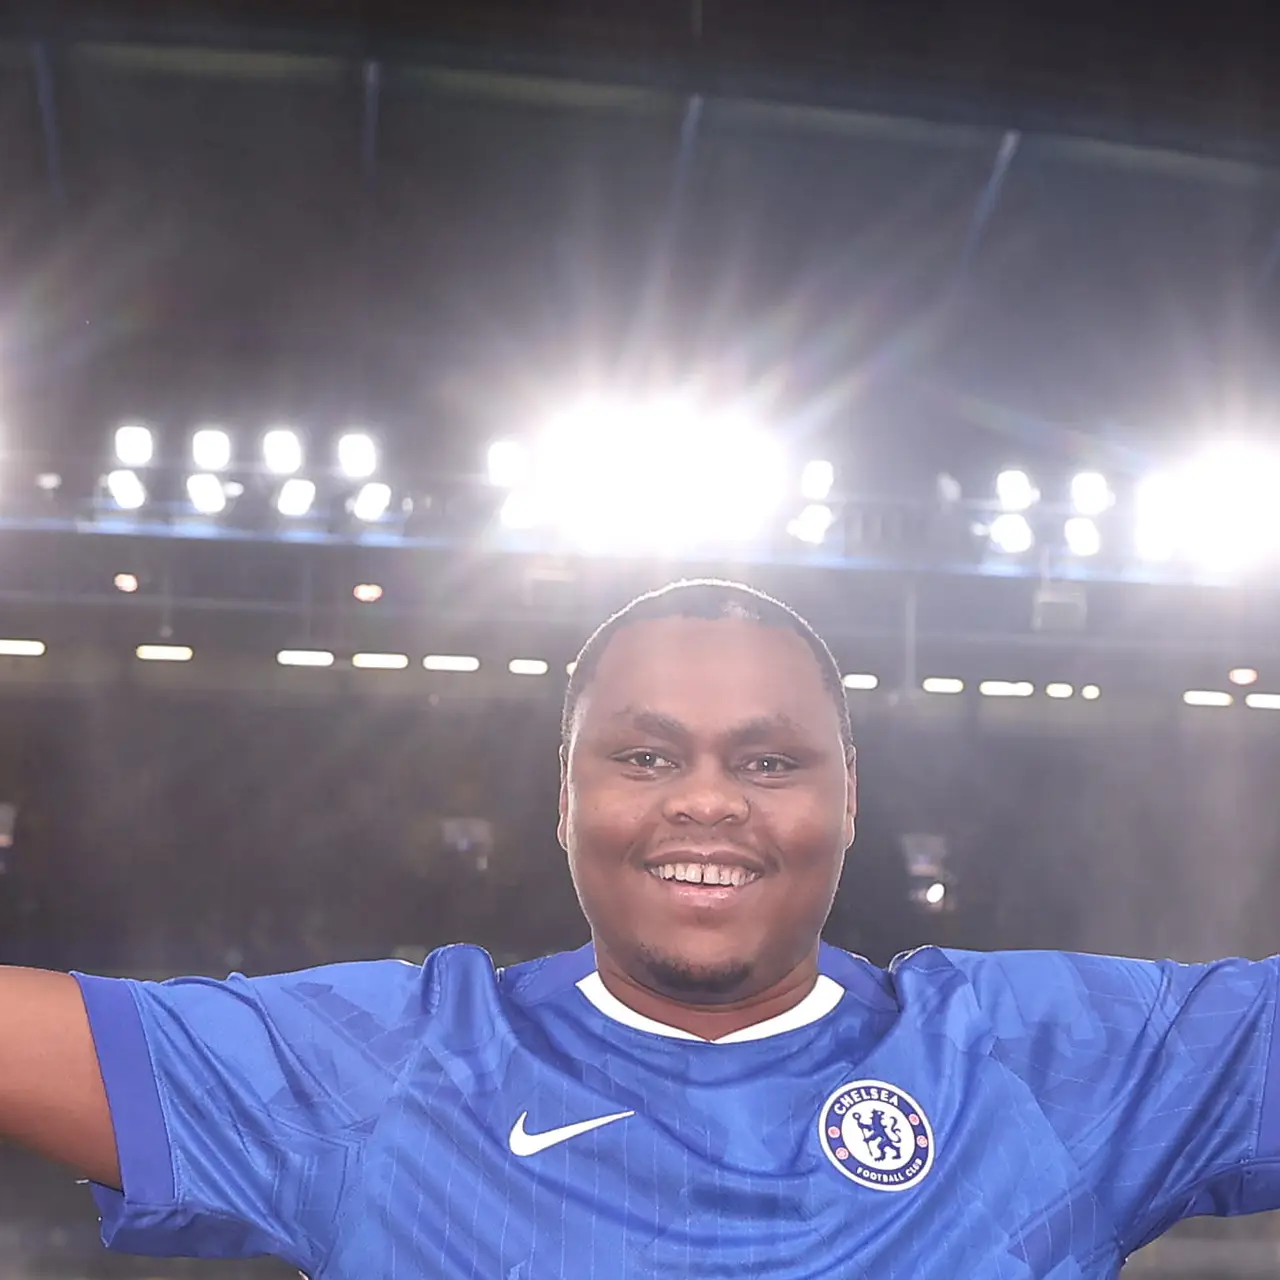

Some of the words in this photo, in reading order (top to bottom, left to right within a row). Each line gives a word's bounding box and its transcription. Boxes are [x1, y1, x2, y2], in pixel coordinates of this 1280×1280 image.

[833, 1088, 899, 1115] CHELSEA
[856, 1166, 904, 1182] FOOTBALL
[905, 1158, 923, 1176] CLUB
